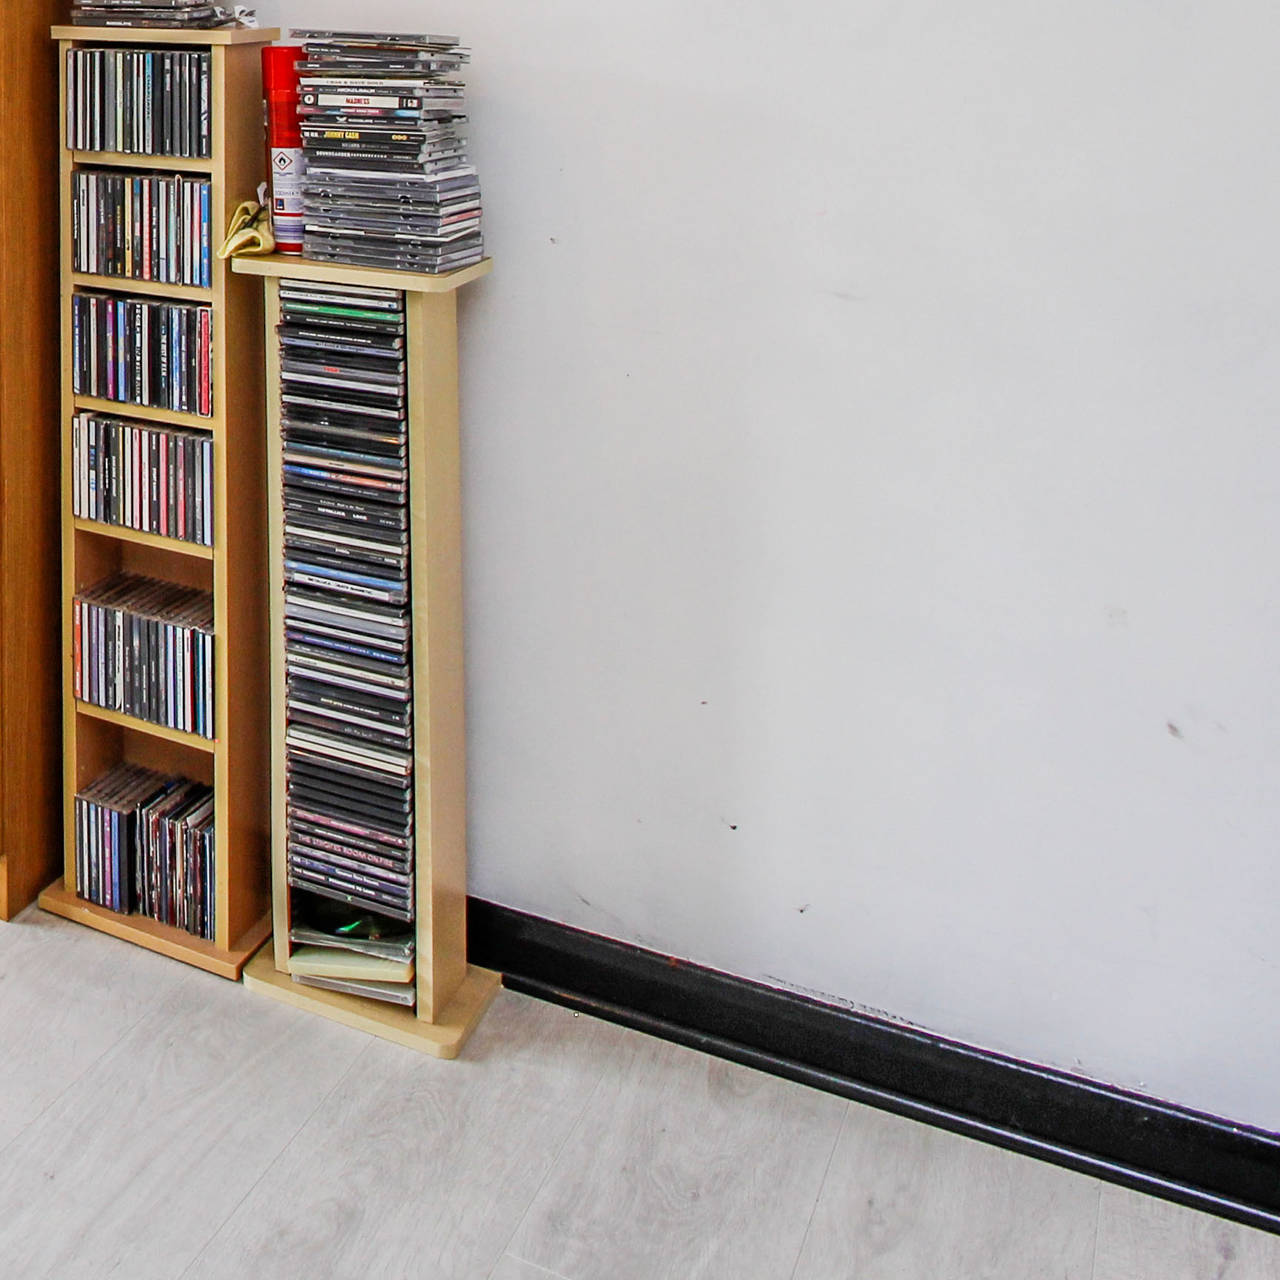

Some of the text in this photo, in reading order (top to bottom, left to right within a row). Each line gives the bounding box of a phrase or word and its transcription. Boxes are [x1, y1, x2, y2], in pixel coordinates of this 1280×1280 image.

[345, 97, 371, 105] MADNESS
[324, 130, 360, 140] JOHNNY CASH
[343, 848, 367, 861] ROOM
[367, 854, 380, 864] ON
